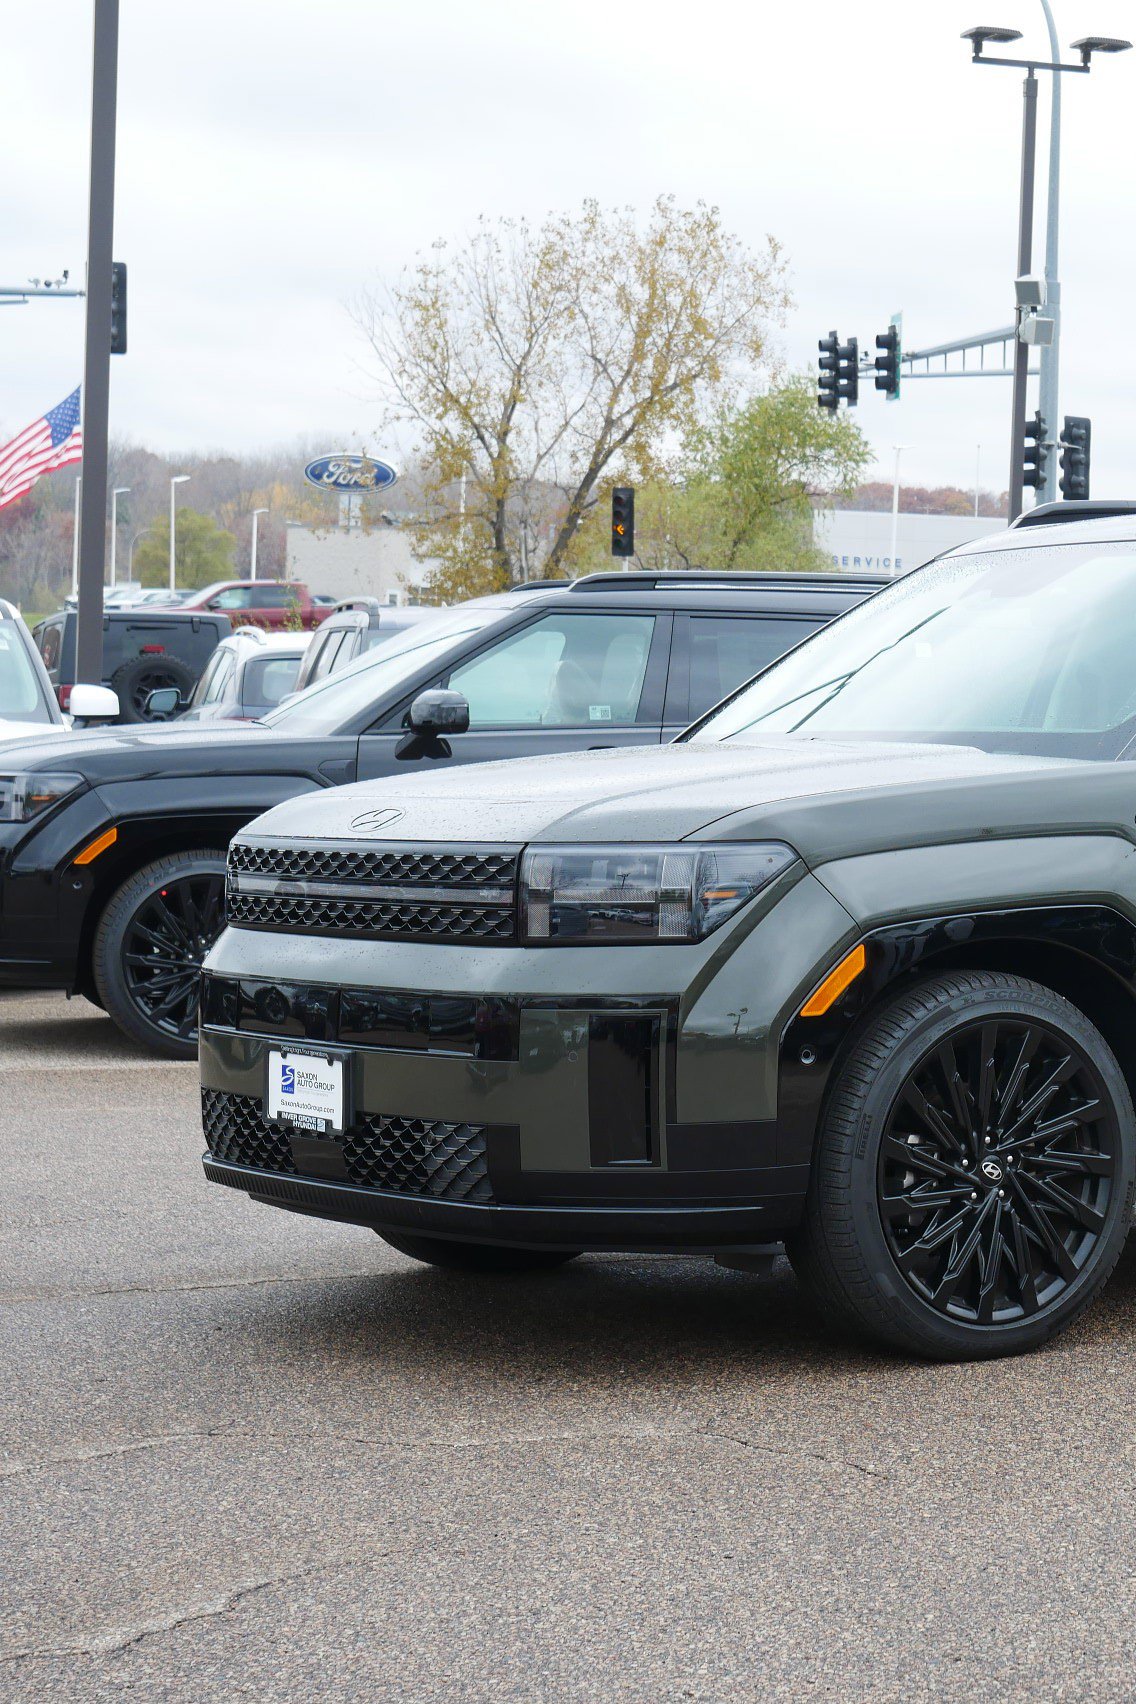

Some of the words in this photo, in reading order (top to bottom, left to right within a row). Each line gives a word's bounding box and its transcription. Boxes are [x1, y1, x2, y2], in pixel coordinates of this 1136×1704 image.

[322, 460, 379, 487] Ford
[831, 555, 903, 569] SERVICE
[296, 1071, 318, 1081] SAXON
[296, 1080, 313, 1089] AUTO
[314, 1082, 335, 1091] GROUP
[280, 1099, 335, 1114] SaxonAutoGroup.com
